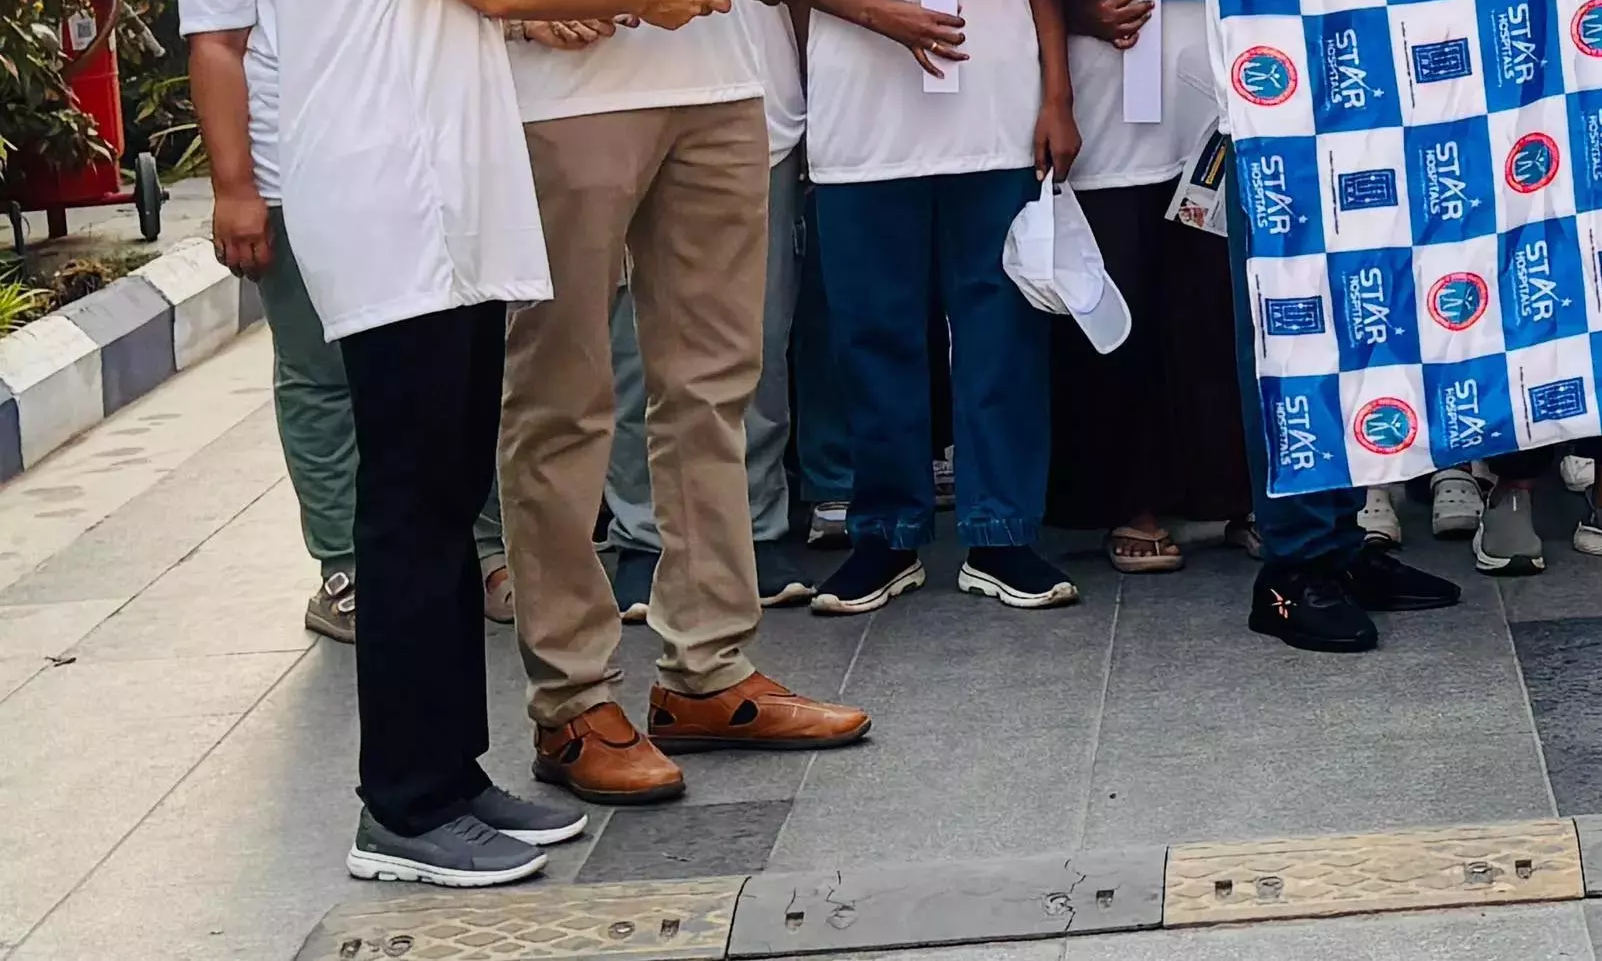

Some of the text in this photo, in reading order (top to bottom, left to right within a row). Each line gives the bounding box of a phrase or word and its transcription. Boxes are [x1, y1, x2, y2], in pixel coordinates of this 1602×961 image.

[1325, 39, 1343, 104] HOSPITALS
[1336, 29, 1367, 108] STAR
[1498, 14, 1515, 79] HOSPITALS
[1508, 3, 1536, 84] STAR
[1251, 162, 1269, 229] HOSPITALS
[1260, 155, 1292, 235] STAR
[1435, 141, 1466, 221] STAR
[1349, 275, 1365, 341] HOSPITALS
[1360, 267, 1391, 344] STAR
[1514, 251, 1532, 318] HOSPITALS
[1526, 241, 1557, 322] STAR
[1285, 395, 1318, 471] STAR
[1455, 379, 1486, 448] STAR
